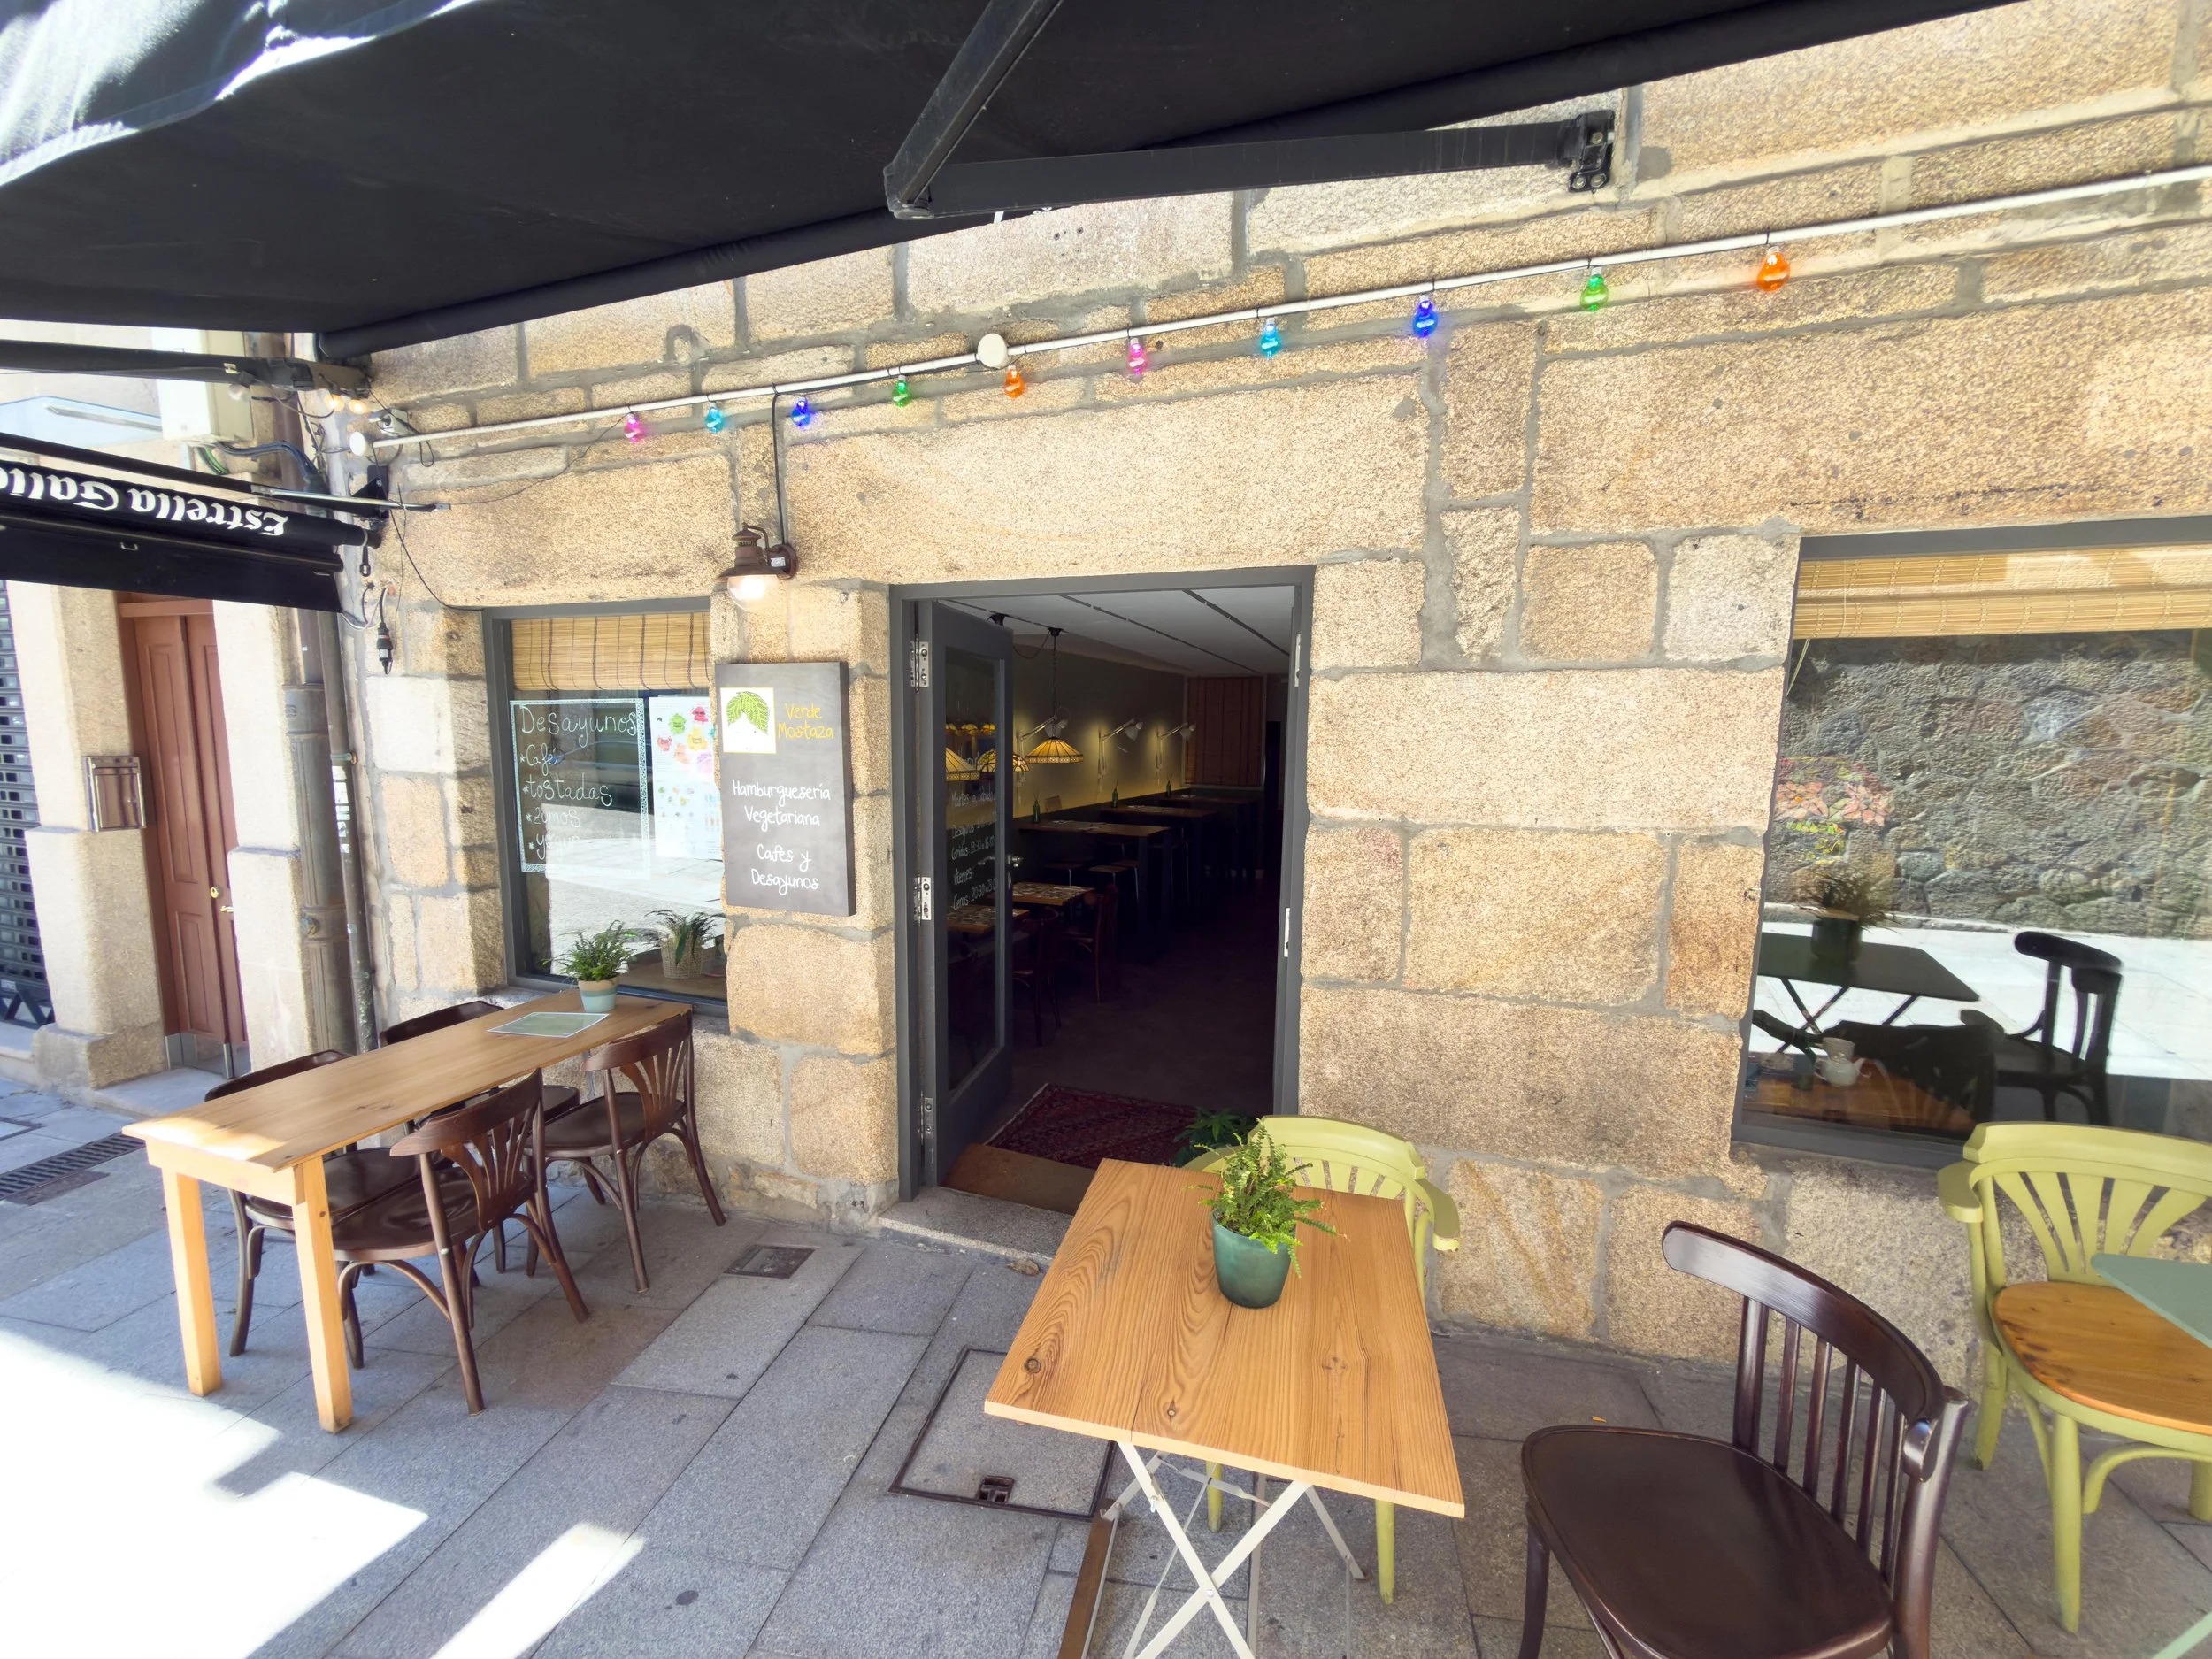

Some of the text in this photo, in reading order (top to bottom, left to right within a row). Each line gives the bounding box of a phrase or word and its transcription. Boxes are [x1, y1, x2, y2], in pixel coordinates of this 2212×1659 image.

[127, 488, 289, 536] Estrella
[784, 703, 823, 720] Verde
[521, 705, 638, 748] Desayunos
[778, 722, 834, 740] Mostaza
[733, 780, 831, 807] Hamburguesería
[744, 805, 820, 832] Vegetariana
[800, 850, 812, 872] y
[751, 868, 819, 895] Desayunos
